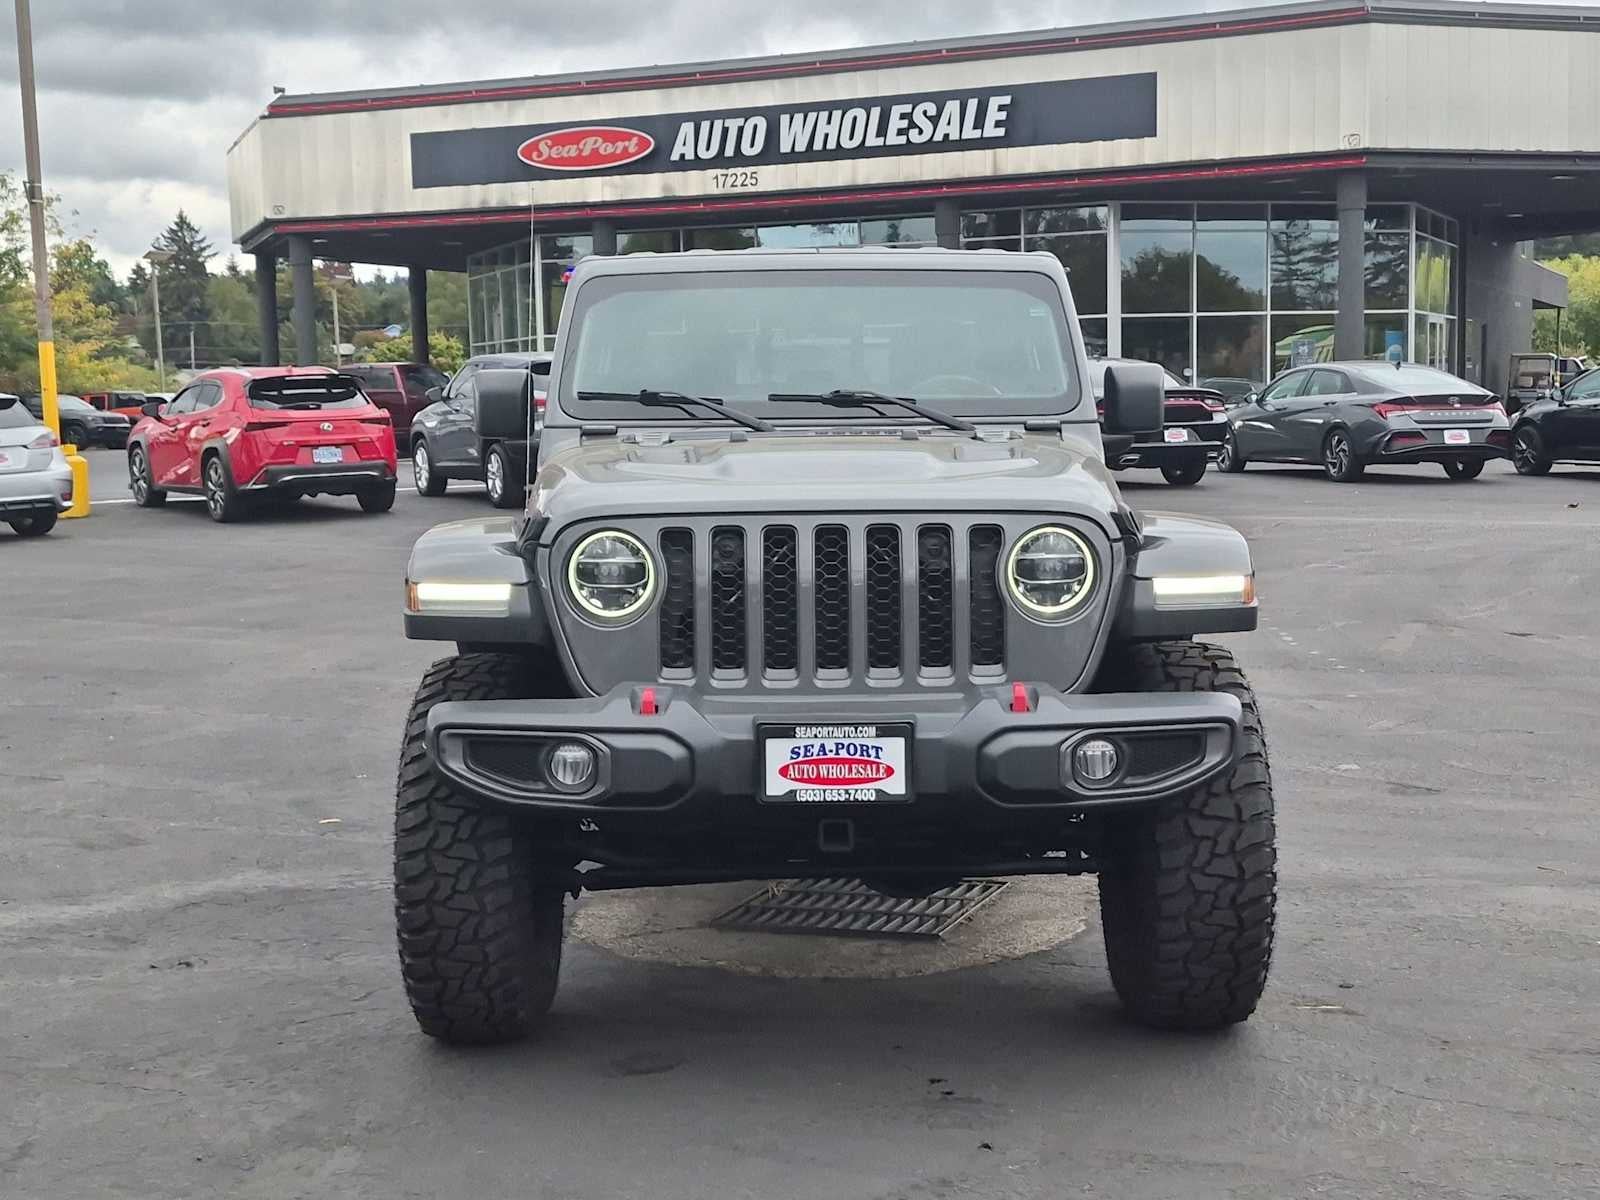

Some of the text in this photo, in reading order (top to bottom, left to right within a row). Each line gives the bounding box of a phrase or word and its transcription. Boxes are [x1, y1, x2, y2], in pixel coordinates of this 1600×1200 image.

[532, 95, 1012, 161] SeaPort AUTO WHOLESALE
[712, 171, 759, 189] 17225
[795, 726, 877, 738] SEAPORTAUTO.COM
[789, 742, 883, 760] SEA-PORT
[787, 763, 887, 779] AUTO WHOLESALE
